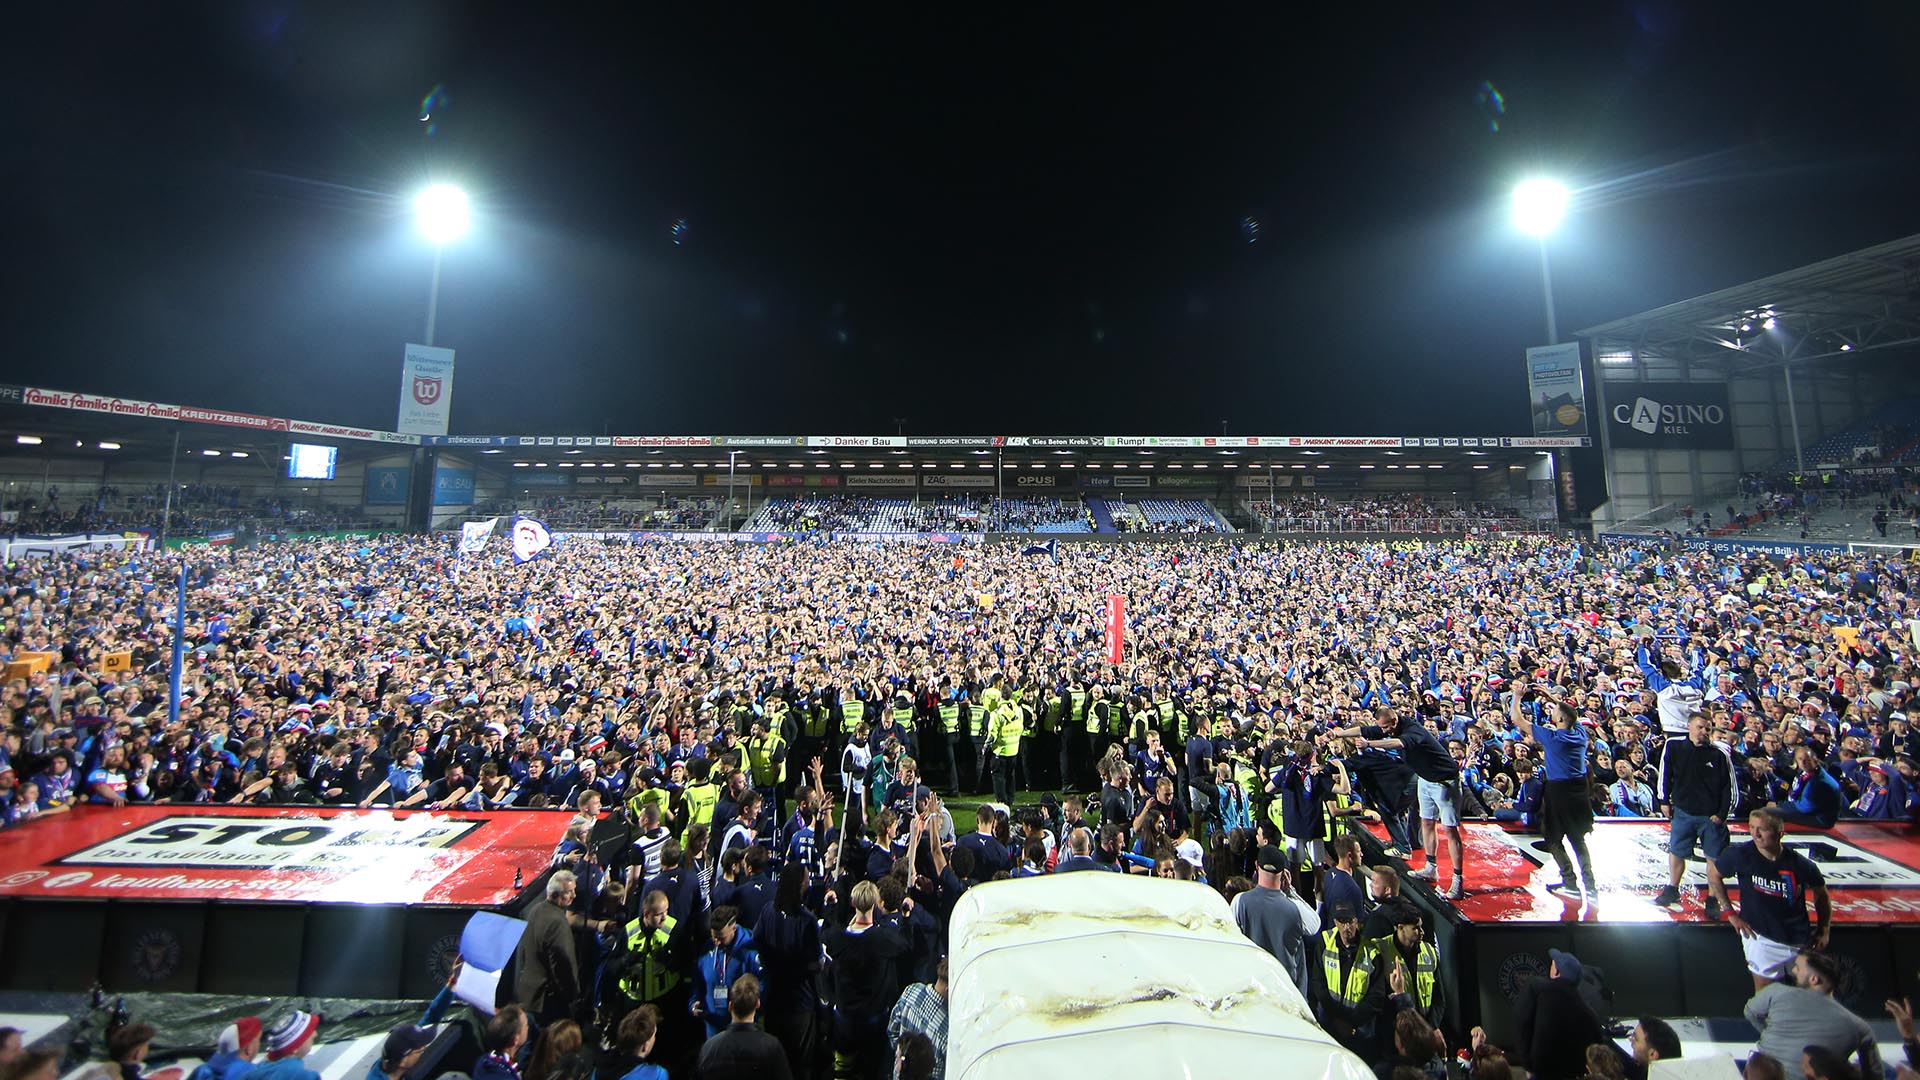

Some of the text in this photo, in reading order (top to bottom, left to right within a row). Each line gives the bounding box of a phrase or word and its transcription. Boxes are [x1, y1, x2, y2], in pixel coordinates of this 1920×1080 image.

[26, 389, 68, 406] famila
[70, 393, 108, 409] famila
[110, 399, 145, 414] famila
[147, 403, 179, 418] famila
[181, 409, 268, 426] KREUTZBERGER
[1613, 404, 1724, 424] CASINO
[1664, 425, 1689, 434] KIEL
[614, 437, 638, 446] famila
[638, 437, 662, 446] famila
[662, 437, 686, 446] famila
[686, 437, 710, 446] famila
[727, 437, 765, 445] Autodienst
[766, 437, 792, 445] Menzel
[835, 437, 891, 446] Danker Bau
[1006, 437, 1031, 447] KBK
[1032, 438, 1048, 446] Kies
[1049, 438, 1068, 446] Beton
[1069, 438, 1089, 446] Krebs
[1117, 437, 1146, 447] Rumpf
[1517, 438, 1575, 446] Linke-Metallbau
[868, 477, 905, 485] Nachrichten
[927, 476, 945, 484] ZAG
[1017, 476, 1052, 484] OPUS
[147, 850, 264, 861] Kaufhaus
